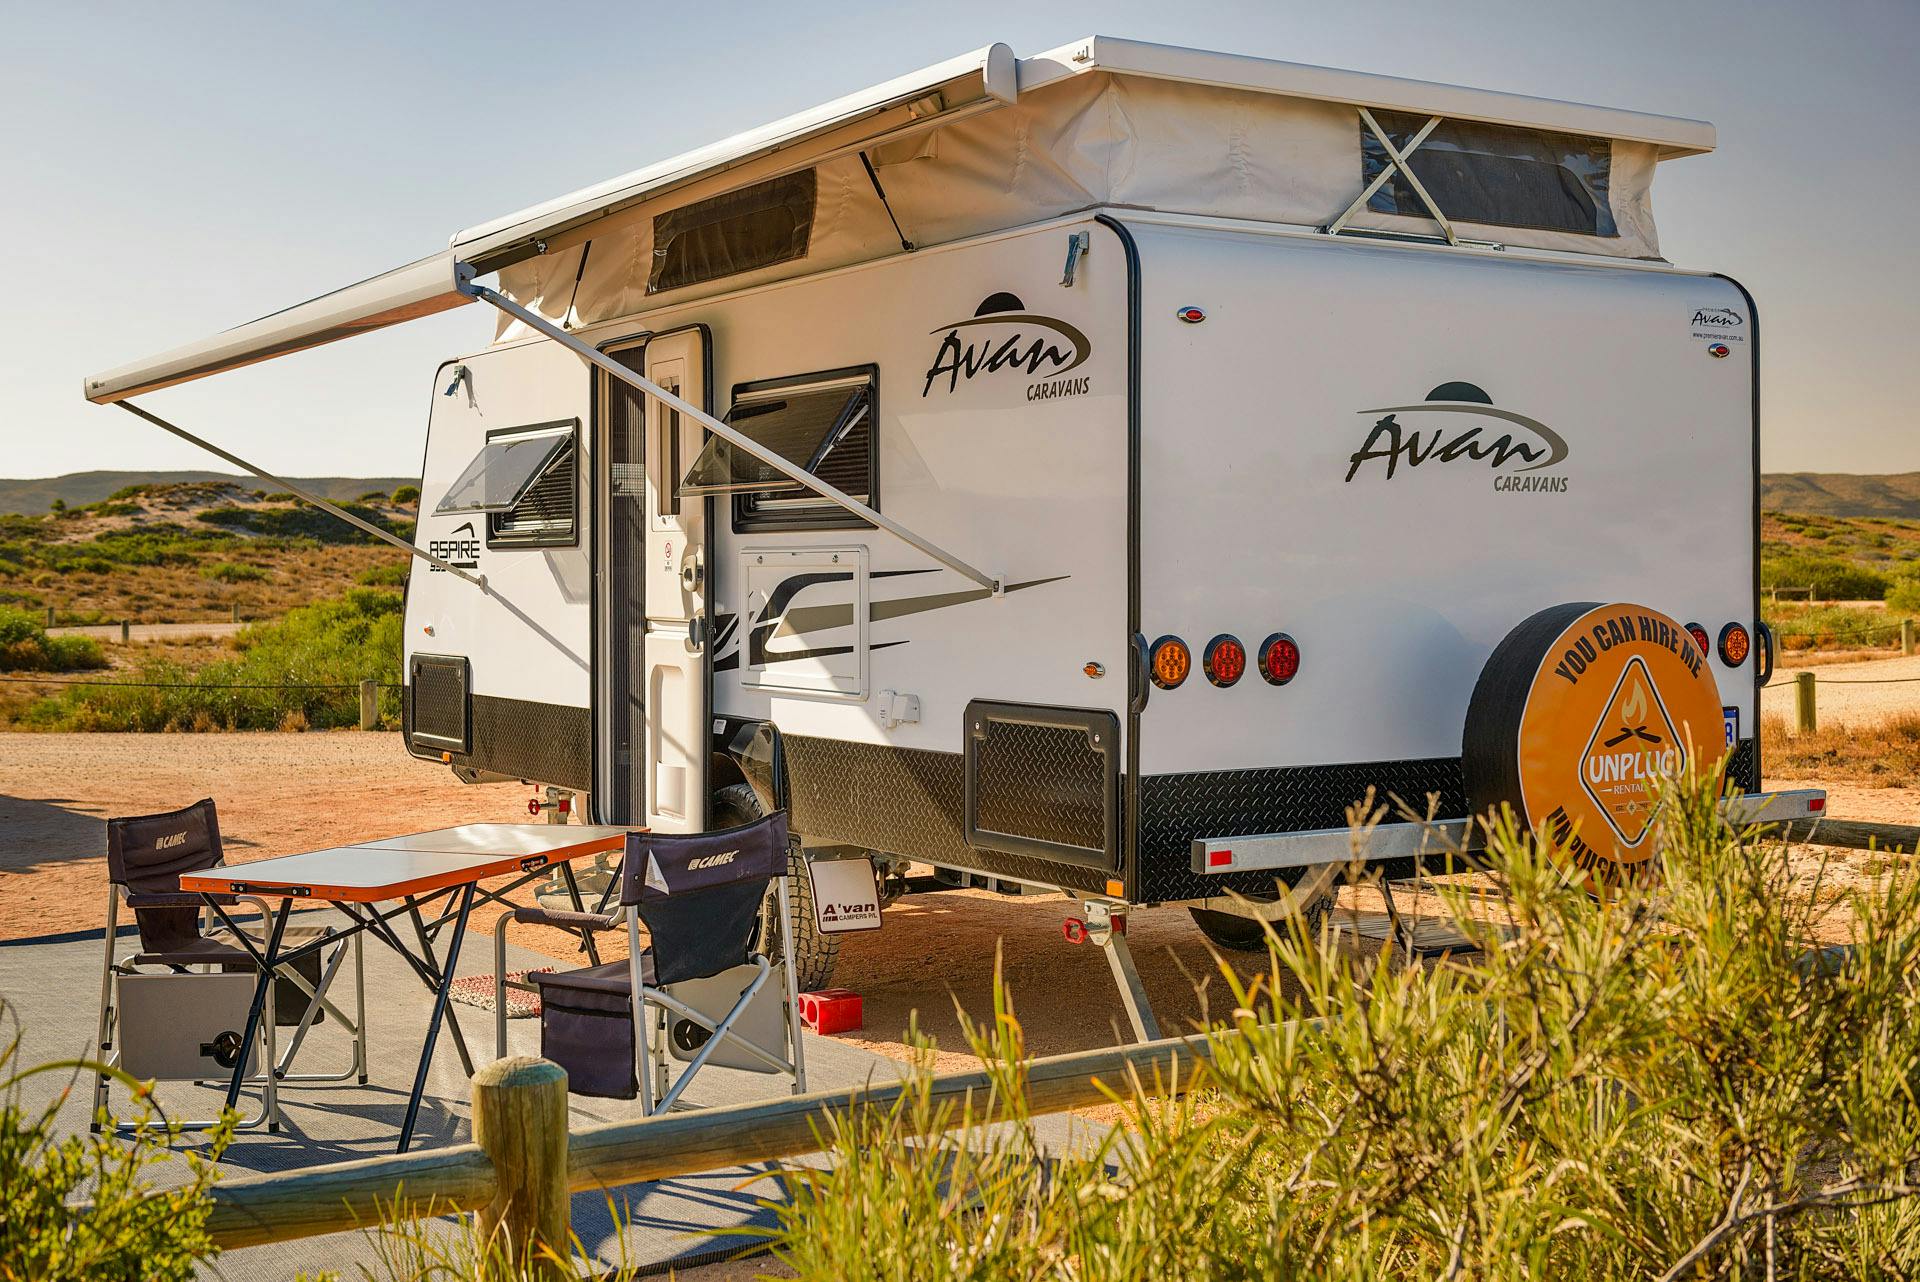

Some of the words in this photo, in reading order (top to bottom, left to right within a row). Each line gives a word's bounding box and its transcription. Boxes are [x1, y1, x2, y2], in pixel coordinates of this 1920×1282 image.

[1691, 311, 1734, 327] Avan
[923, 330, 1073, 397] Avan
[1026, 376, 1090, 401] CARAVANS
[1345, 414, 1546, 482] Avan
[1494, 475, 1568, 493] CARAVANS
[429, 540, 480, 559] ASPIRE
[1555, 636, 1598, 685] YOU
[1592, 616, 1637, 653] CAN
[1638, 615, 1679, 655] HIRE
[1681, 638, 1703, 679] ME
[1613, 782, 1648, 795] RENTAL
[163, 831, 188, 849] CAMEC
[698, 850, 740, 869] CAMEC
[822, 903, 876, 916] A'van
[838, 913, 868, 921] CAMPERS
